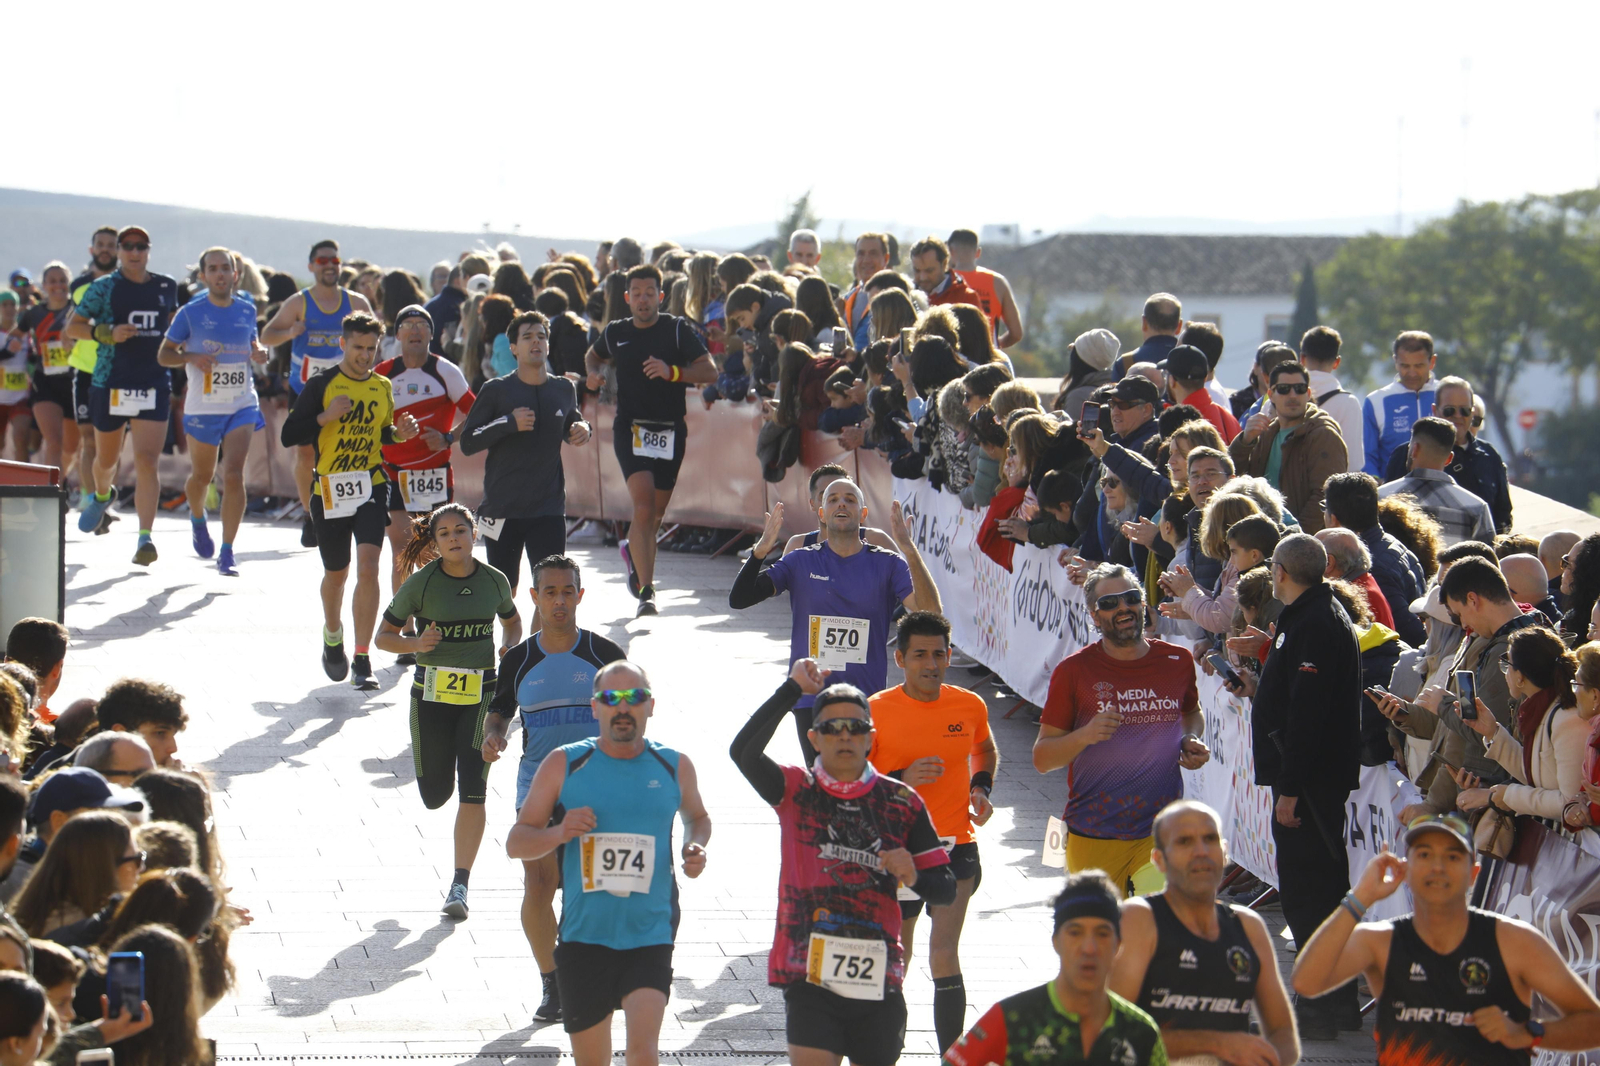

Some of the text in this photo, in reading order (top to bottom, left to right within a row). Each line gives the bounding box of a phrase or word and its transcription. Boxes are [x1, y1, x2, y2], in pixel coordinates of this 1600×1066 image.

[212, 371, 245, 386] 2368
[338, 425, 345, 435] A
[334, 438, 374, 453] MADA
[644, 432, 667, 448] 686
[329, 453, 369, 472] FAKA
[335, 480, 363, 498] 931
[408, 477, 444, 493] 1845
[825, 627, 859, 648] 570
[446, 672, 468, 692] 21
[1117, 688, 1157, 701] MEDIA
[1119, 695, 1179, 713] MARATÓN
[527, 709, 560, 728] MEDIA
[947, 724, 962, 732] GO
[602, 848, 645, 872] 974
[832, 953, 874, 980] 752
